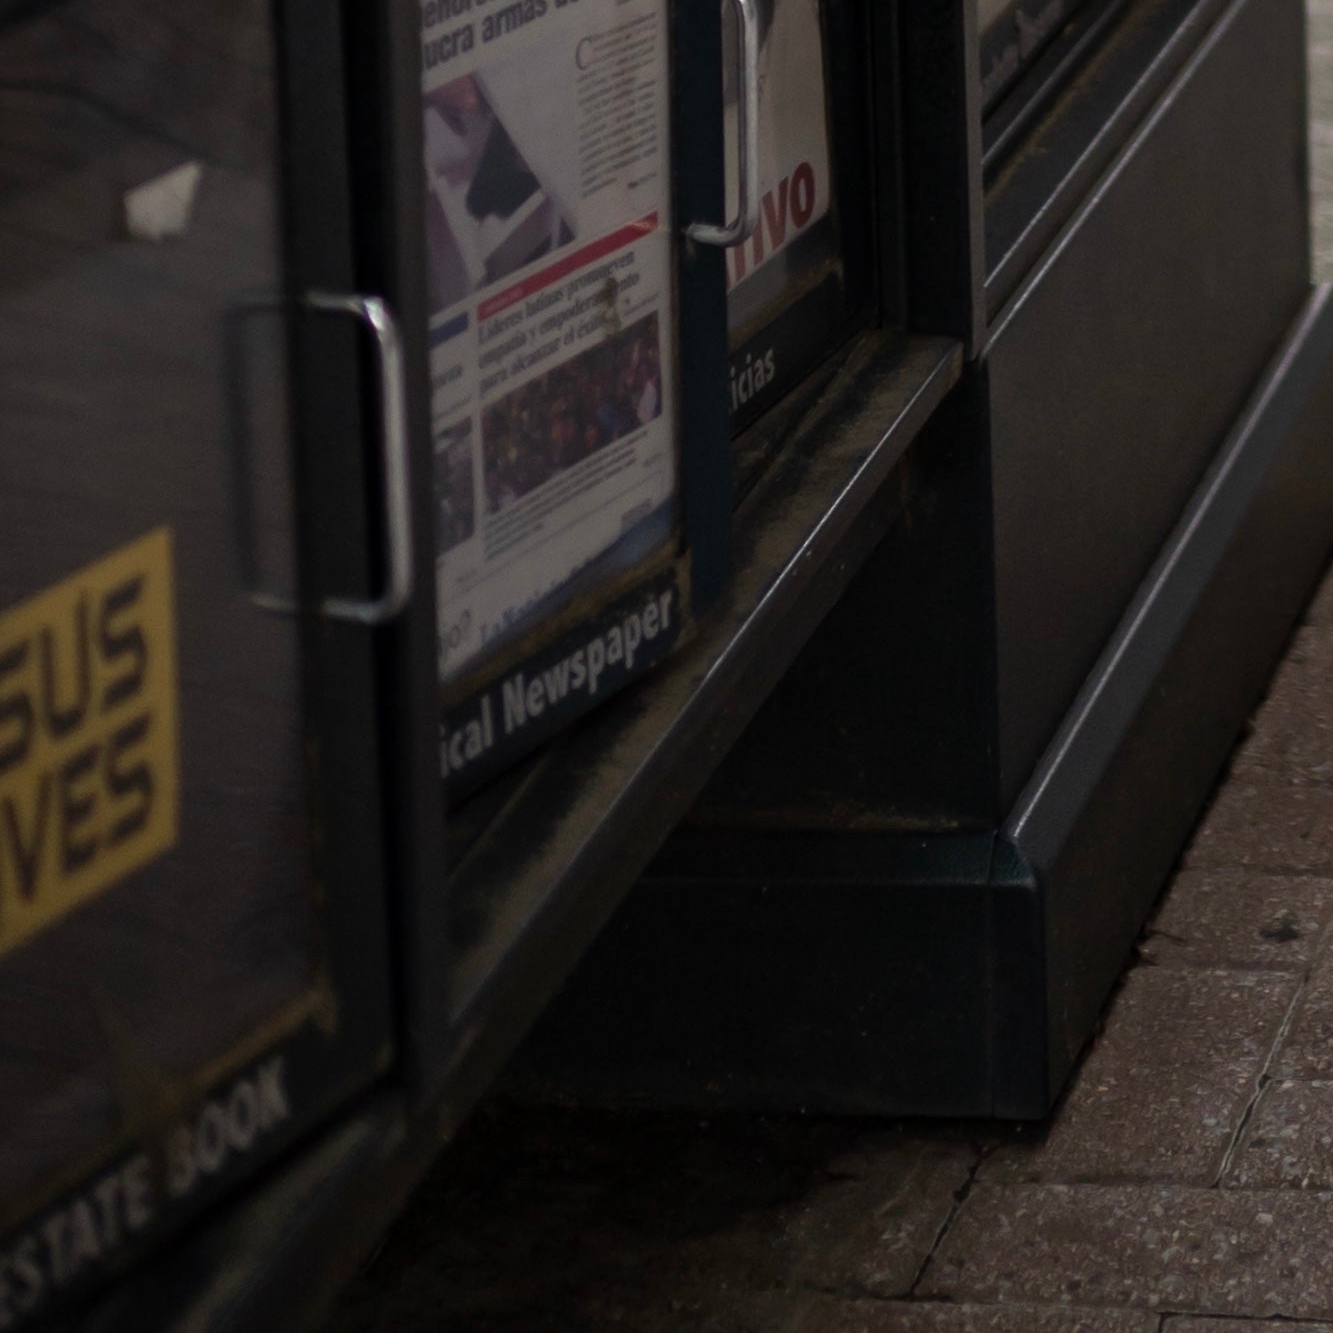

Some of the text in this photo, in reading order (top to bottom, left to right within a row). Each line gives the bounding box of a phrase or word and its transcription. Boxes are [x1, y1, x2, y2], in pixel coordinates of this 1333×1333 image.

[729, 347, 776, 416] icias
[502, 588, 674, 735] Newspaper
[165, 1053, 292, 1200] BOOK
